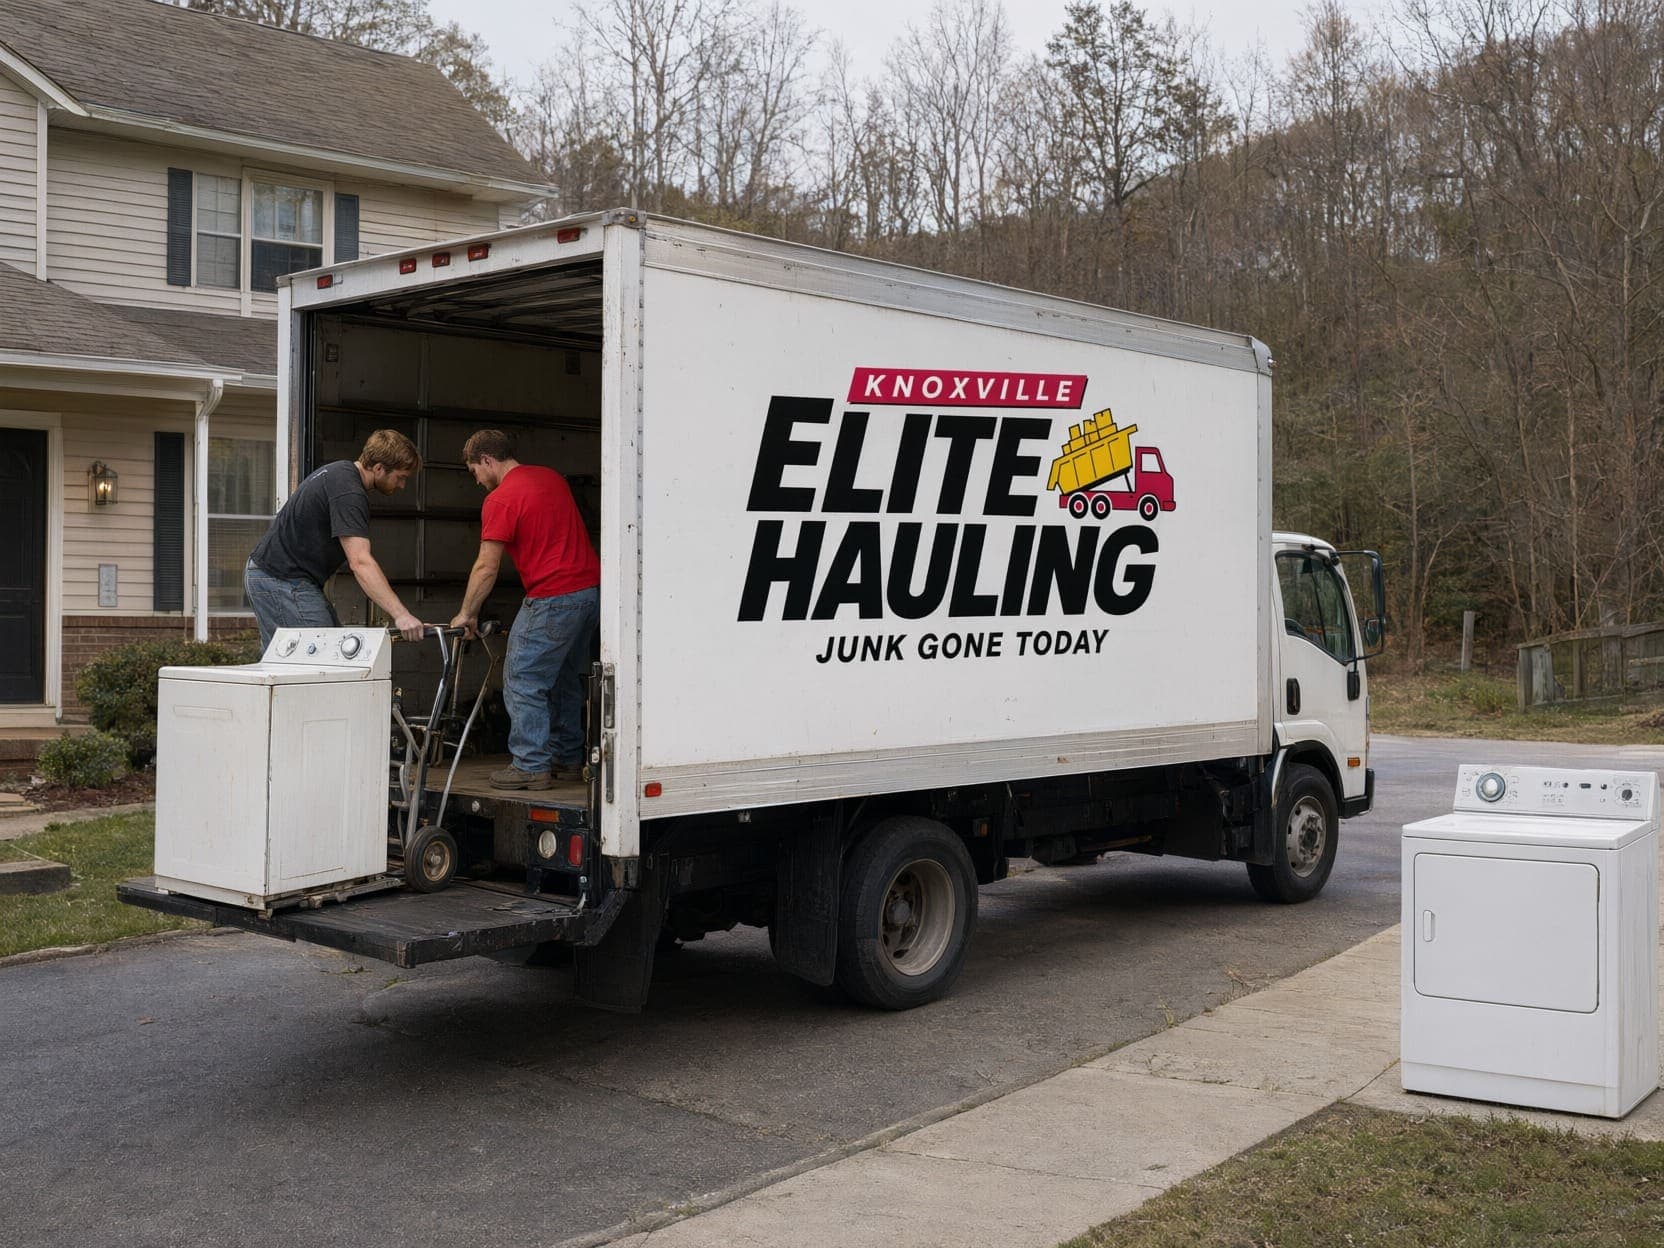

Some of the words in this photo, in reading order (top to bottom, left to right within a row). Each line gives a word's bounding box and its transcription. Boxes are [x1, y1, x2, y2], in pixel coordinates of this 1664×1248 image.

[864, 373, 1074, 402] KNOXVILLE
[746, 395, 1053, 517] ELITE
[737, 519, 1160, 622] HAULING
[816, 633, 907, 664] JUNK
[917, 632, 1002, 660] GONE
[1016, 629, 1110, 657] TODAY
